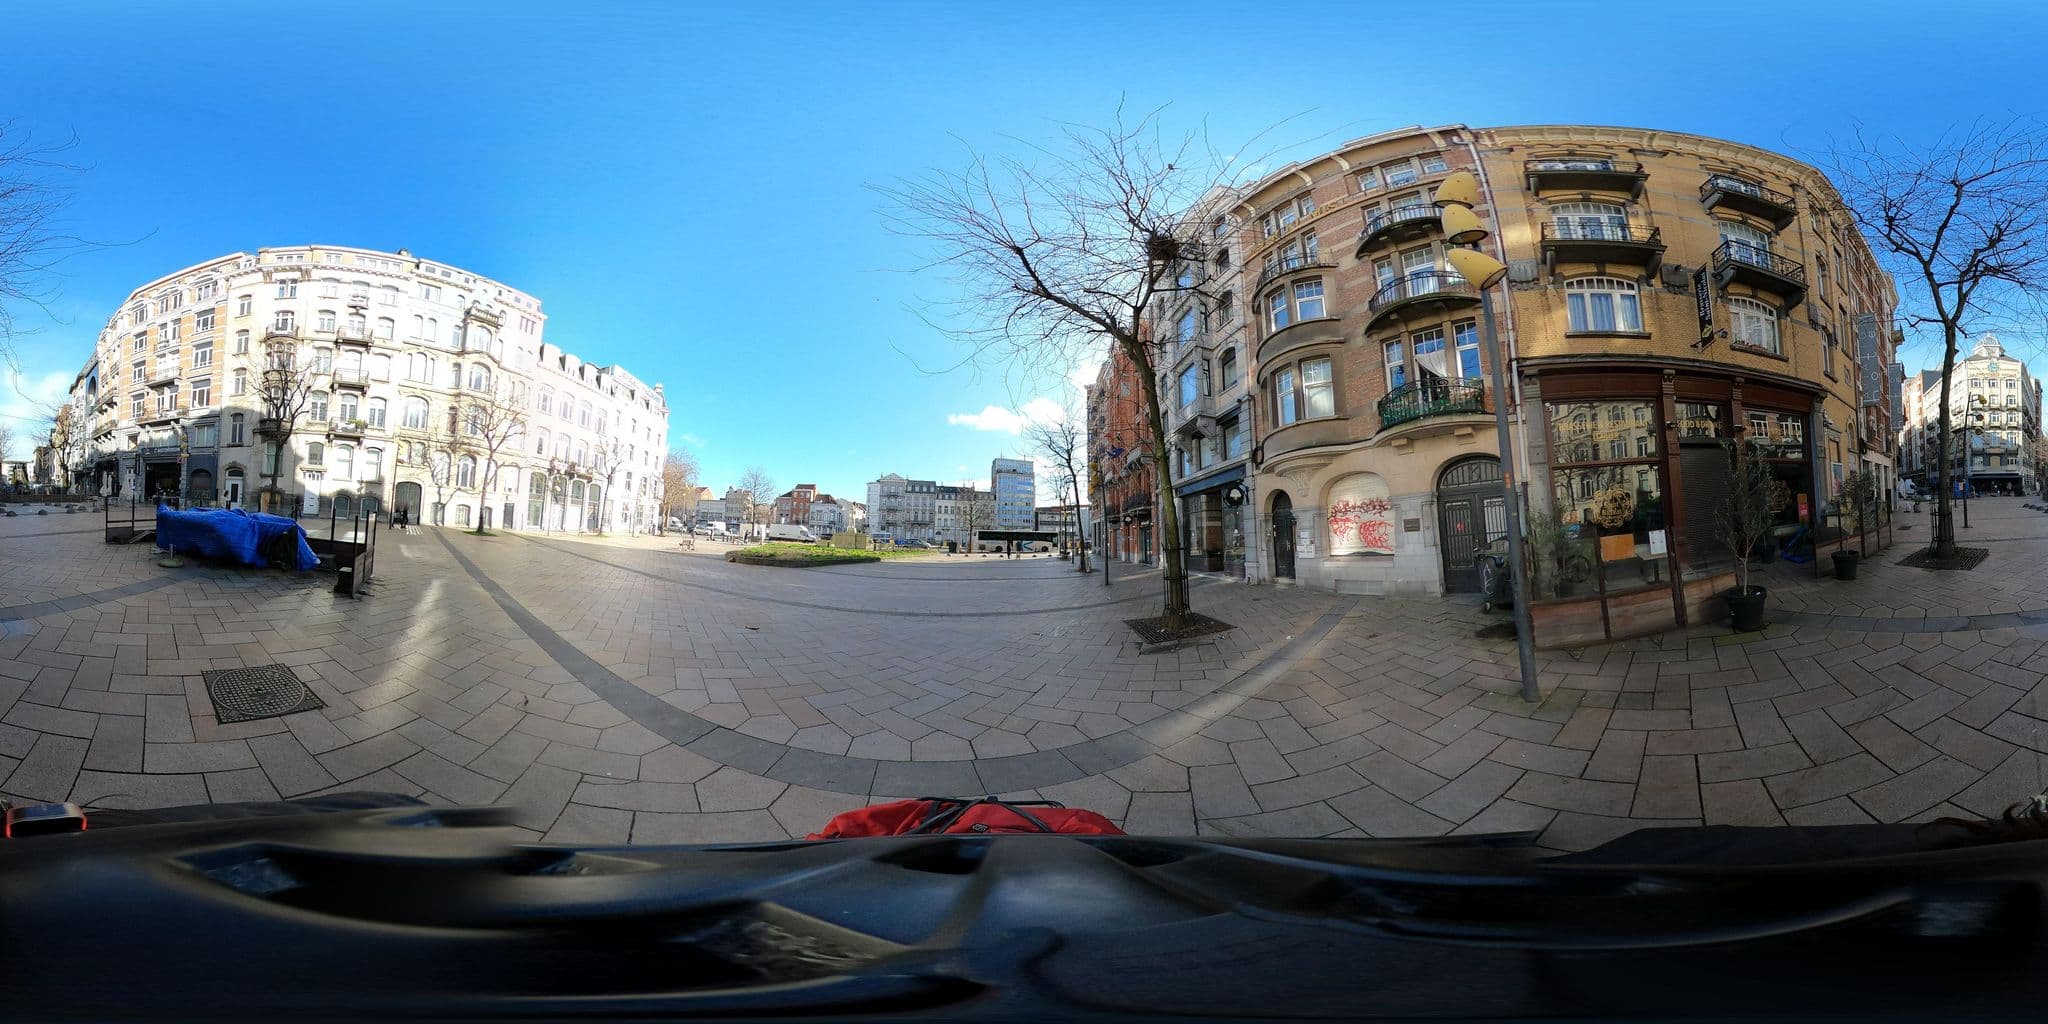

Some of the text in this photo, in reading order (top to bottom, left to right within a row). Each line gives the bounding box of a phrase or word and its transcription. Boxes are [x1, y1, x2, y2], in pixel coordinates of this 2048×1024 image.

[1697, 284, 1705, 316] Brasserie
[1701, 272, 1711, 320] Saint-Nicolas
[1558, 421, 1598, 431] BRASSERIE
